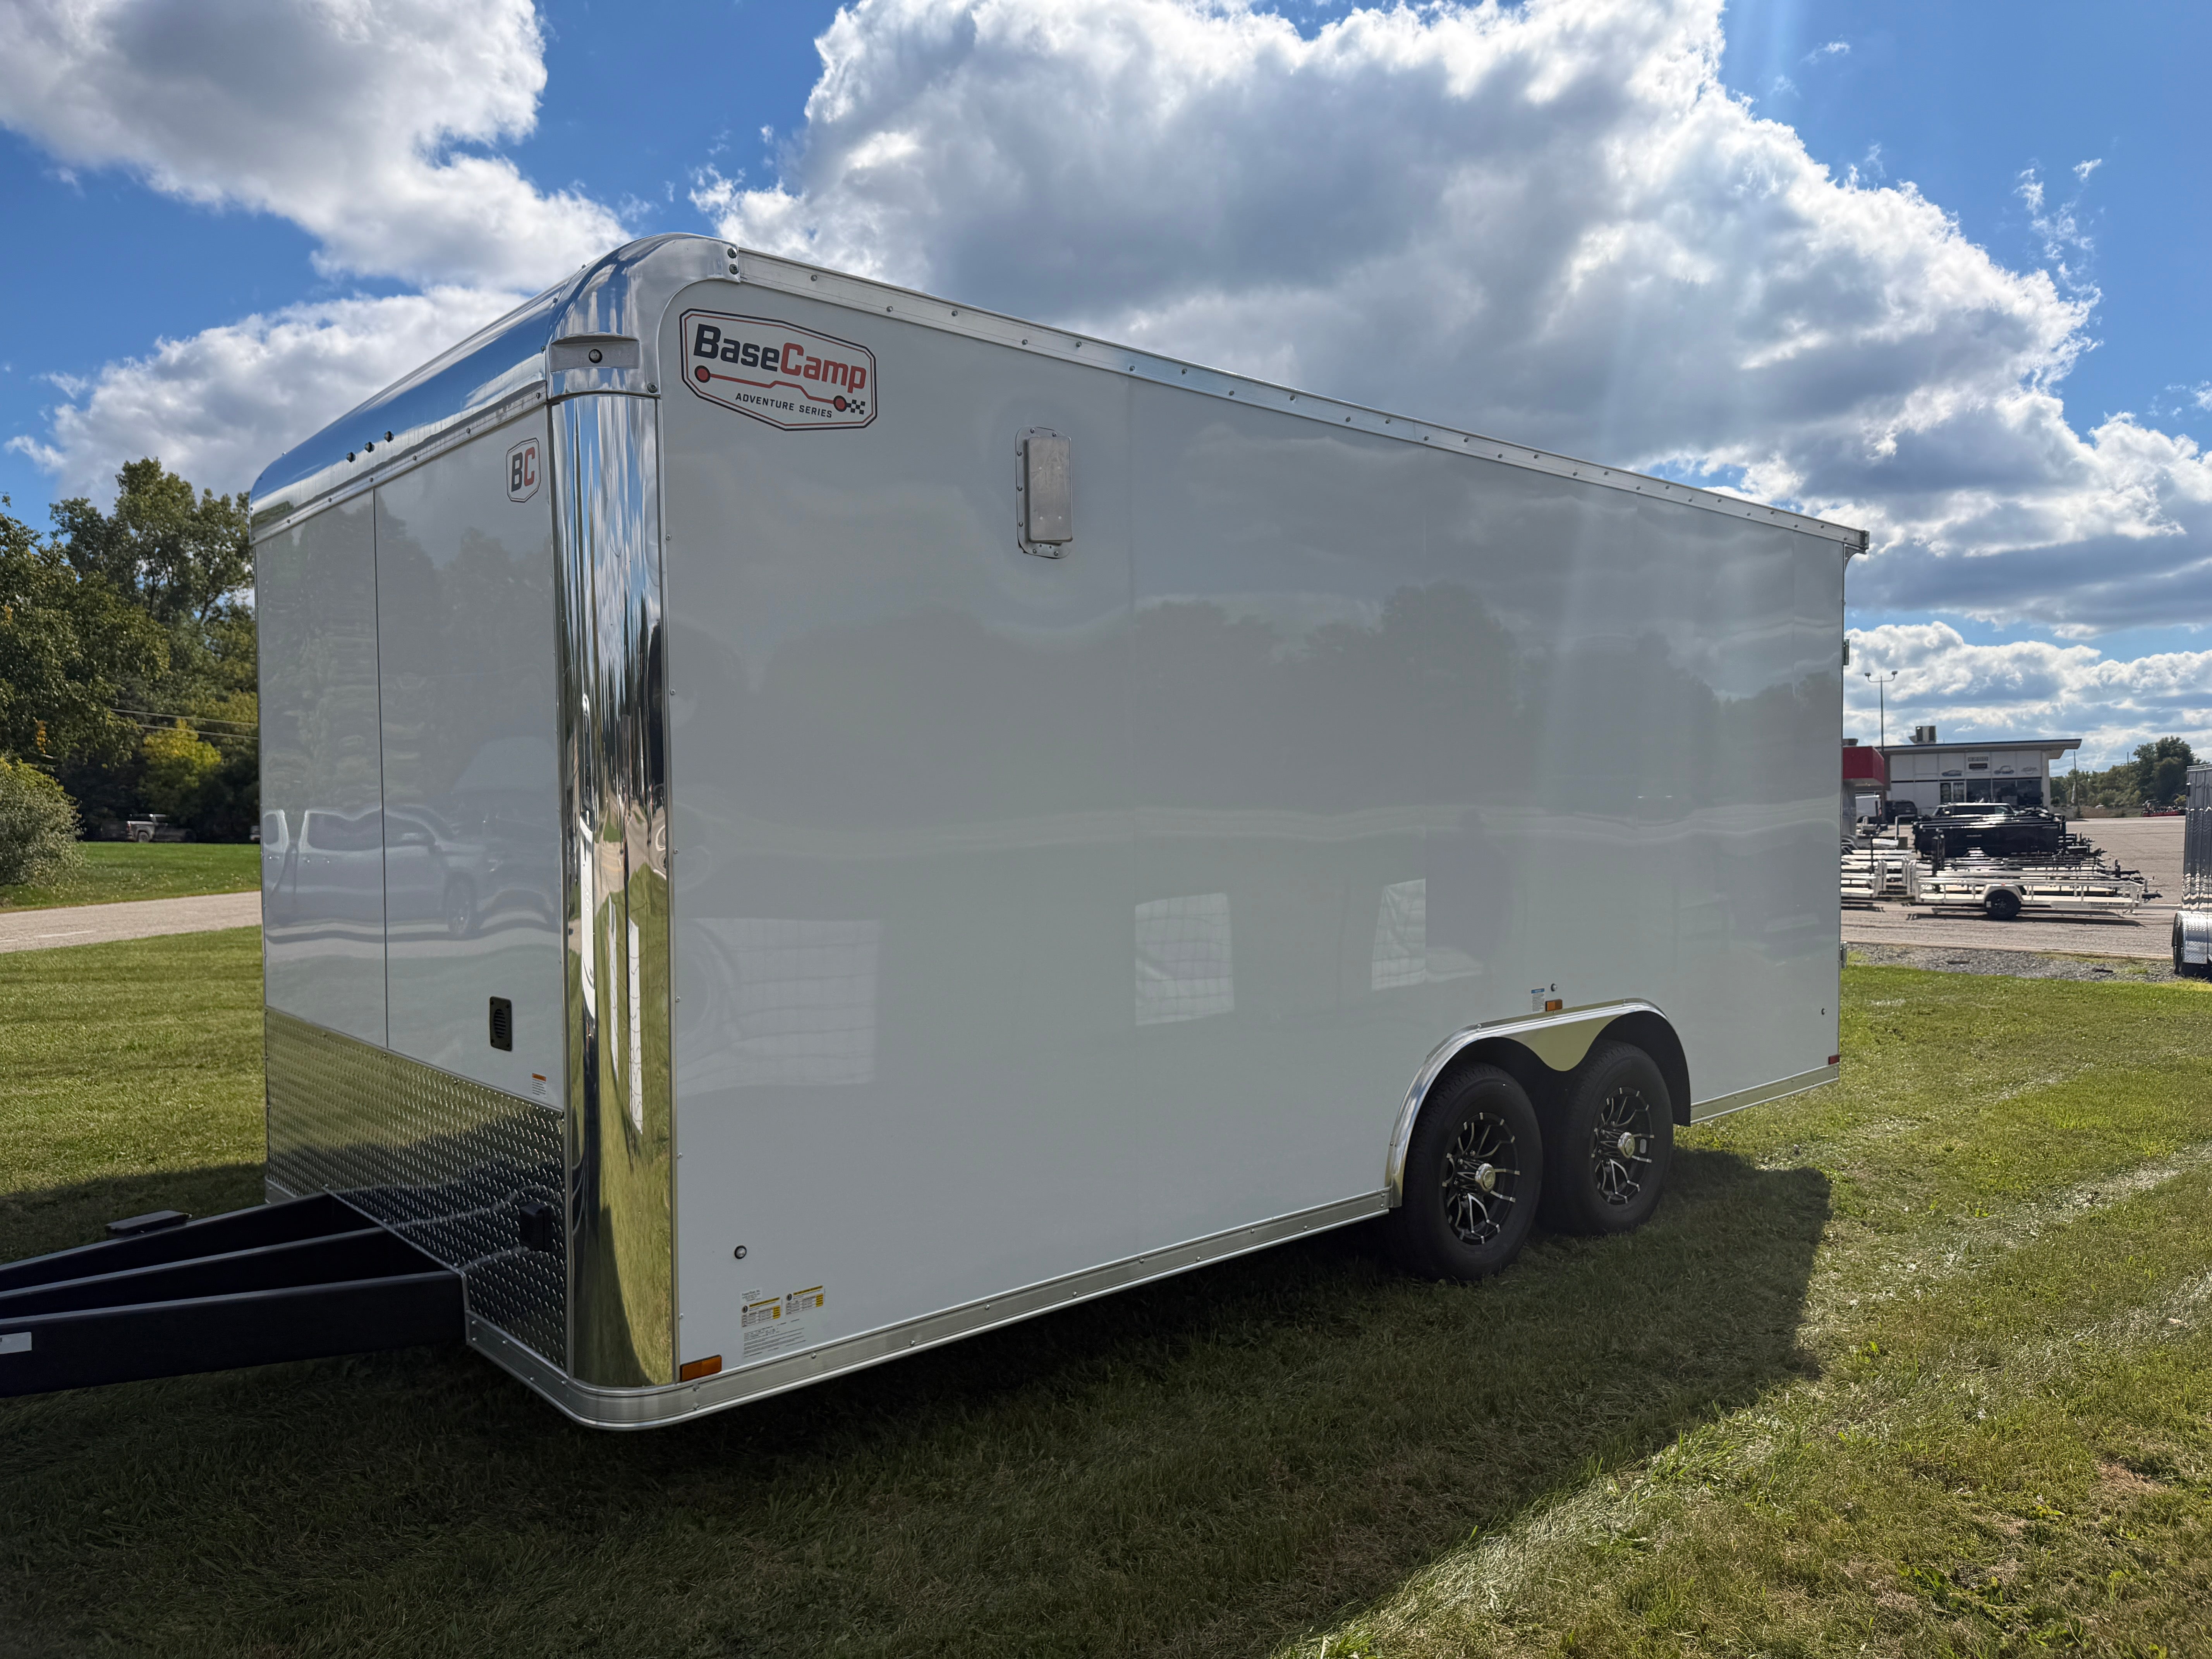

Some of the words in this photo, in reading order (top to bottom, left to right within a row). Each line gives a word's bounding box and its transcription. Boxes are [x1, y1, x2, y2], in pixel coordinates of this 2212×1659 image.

[693, 323, 867, 393] BaseCamp
[735, 393, 794, 411] ADVENTURE
[799, 405, 832, 418] SERIES
[511, 447, 535, 492] BC
